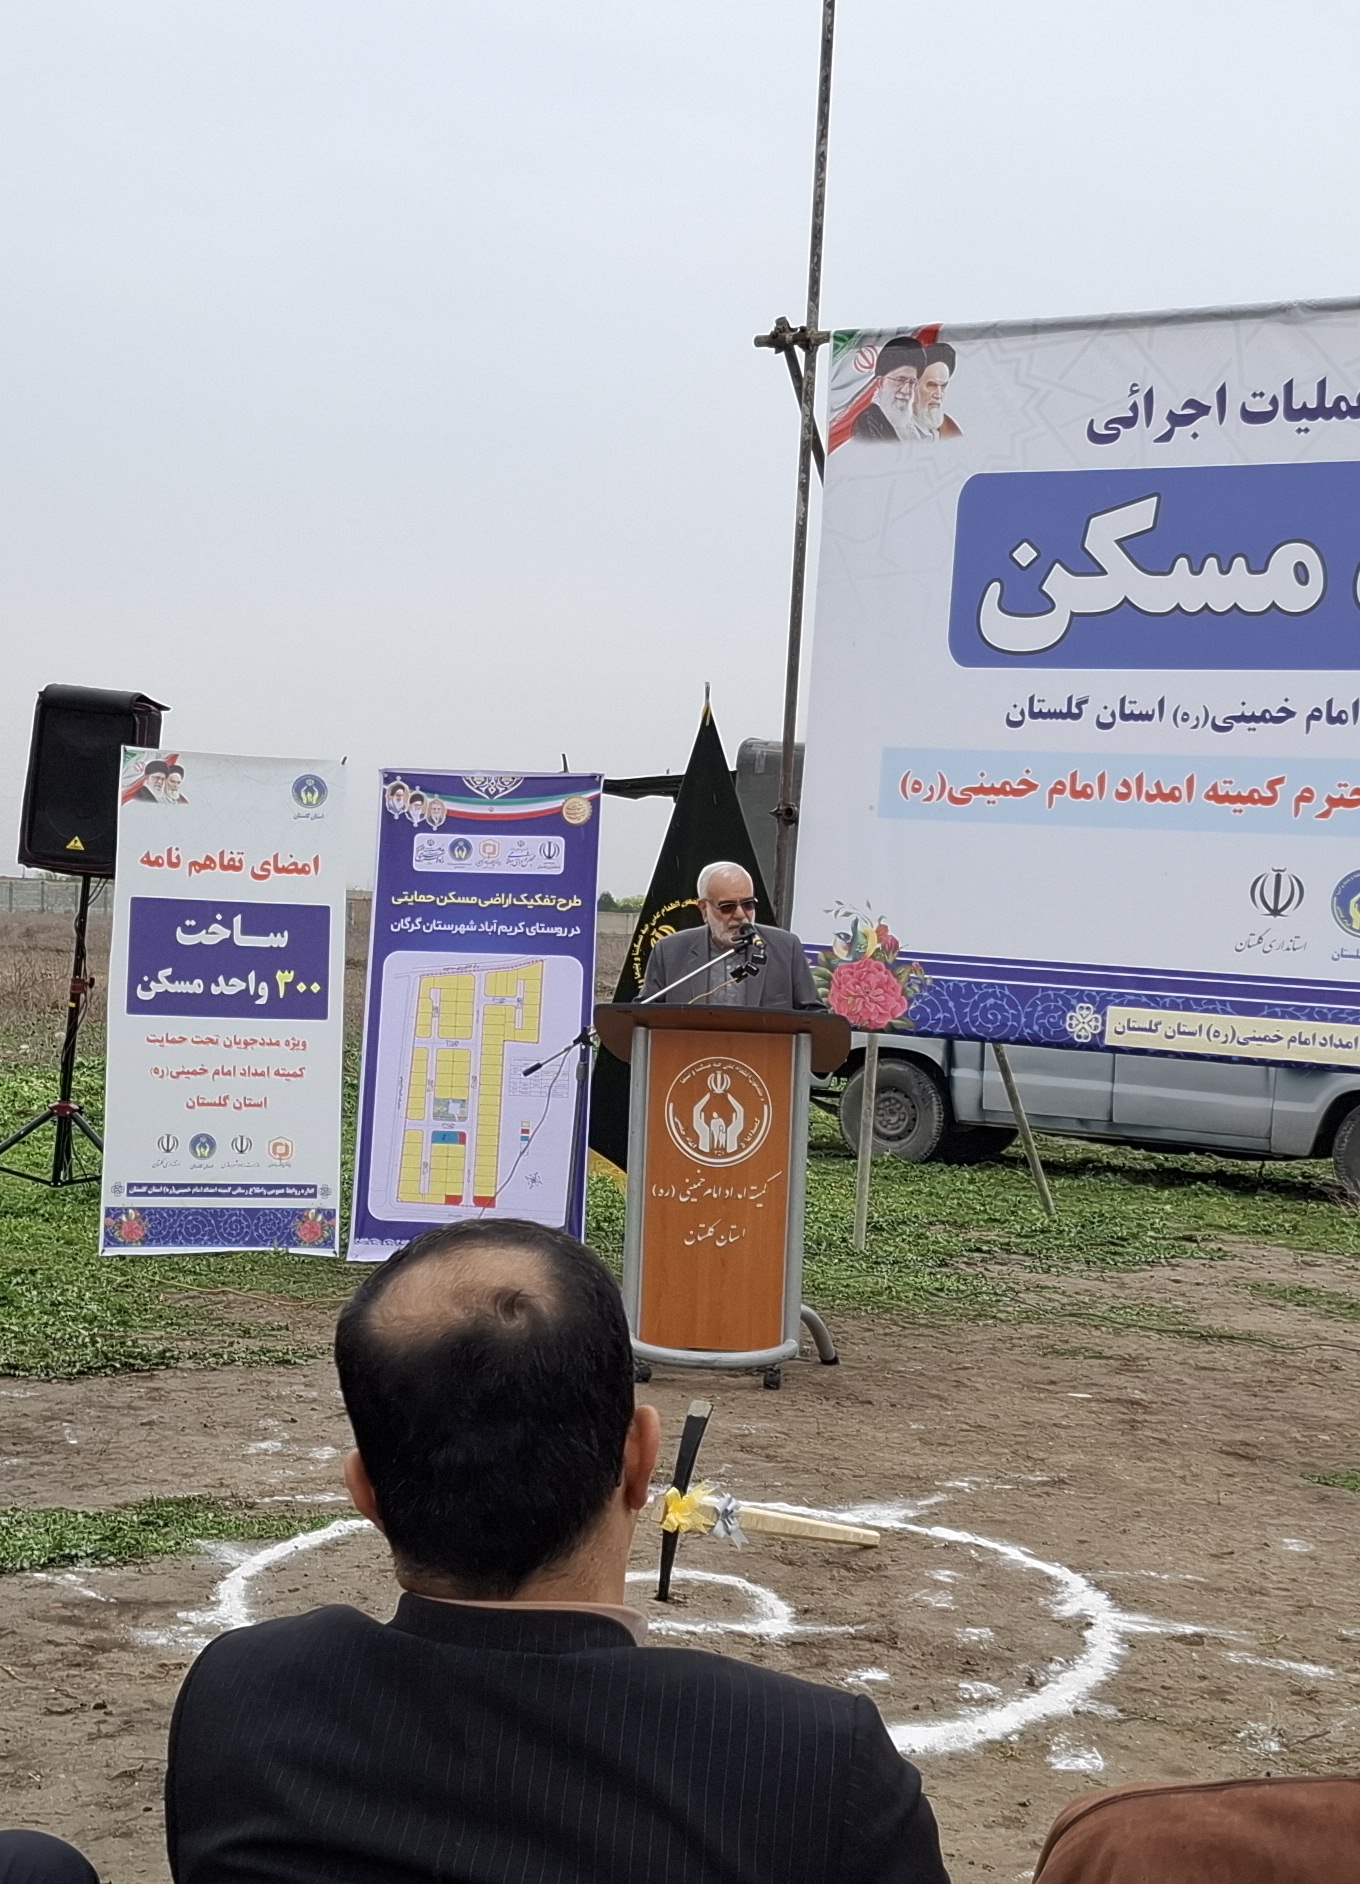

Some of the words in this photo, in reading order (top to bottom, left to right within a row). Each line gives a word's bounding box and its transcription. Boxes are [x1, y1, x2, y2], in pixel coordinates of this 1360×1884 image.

[1085, 383, 1226, 446] اجرائی
[978, 492, 1327, 655] مسکن
[1005, 694, 1090, 728] گلستان
[1095, 695, 1165, 730] استان
[1304, 696, 1360, 736] امام
[1047, 769, 1107, 810] امام
[1114, 770, 1196, 804] امداد
[1203, 776, 1286, 816] کمیته
[139, 847, 182, 869] نامه
[188, 850, 244, 877] تفاهم
[250, 853, 320, 881] امضای
[391, 891, 436, 906] حمایتی
[436, 892, 478, 906] مسکن
[478, 893, 512, 907] اراضی
[513, 894, 557, 909] تفکیک
[556, 896, 582, 911] طرح
[176, 914, 288, 948] ساخت
[391, 917, 422, 932] گرگان
[423, 919, 477, 934] شهرستان
[478, 920, 498, 935] آباد
[498, 922, 525, 936] کریم
[525, 922, 567, 936] روستای
[568, 925, 581, 937] در
[1262, 936, 1307, 954] استانداری
[136, 967, 204, 1000] مسکن
[211, 970, 268, 1005] واحد
[275, 969, 322, 998] ۳۰۰
[1114, 1017, 1162, 1036] گلستان
[1164, 1019, 1202, 1040] استان
[146, 1032, 187, 1047] حمایت
[191, 1034, 220, 1045] تحت
[223, 1034, 280, 1050] مددجویان
[284, 1036, 307, 1051] ویژه
[1287, 1031, 1316, 1050] امام
[1319, 1034, 1359, 1050] امداد
[212, 1065, 236, 1081] امام
[240, 1065, 270, 1078] امداد
[273, 1066, 306, 1081] کمیته
[185, 1095, 230, 1110] گلستان
[233, 1096, 268, 1111] استان
[679, 1169, 705, 1202] خمینی
[703, 1185, 721, 1198] امام
[724, 1186, 746, 1199] اماد
[748, 1171, 782, 1207] کمیته
[715, 1225, 746, 1246] استان
